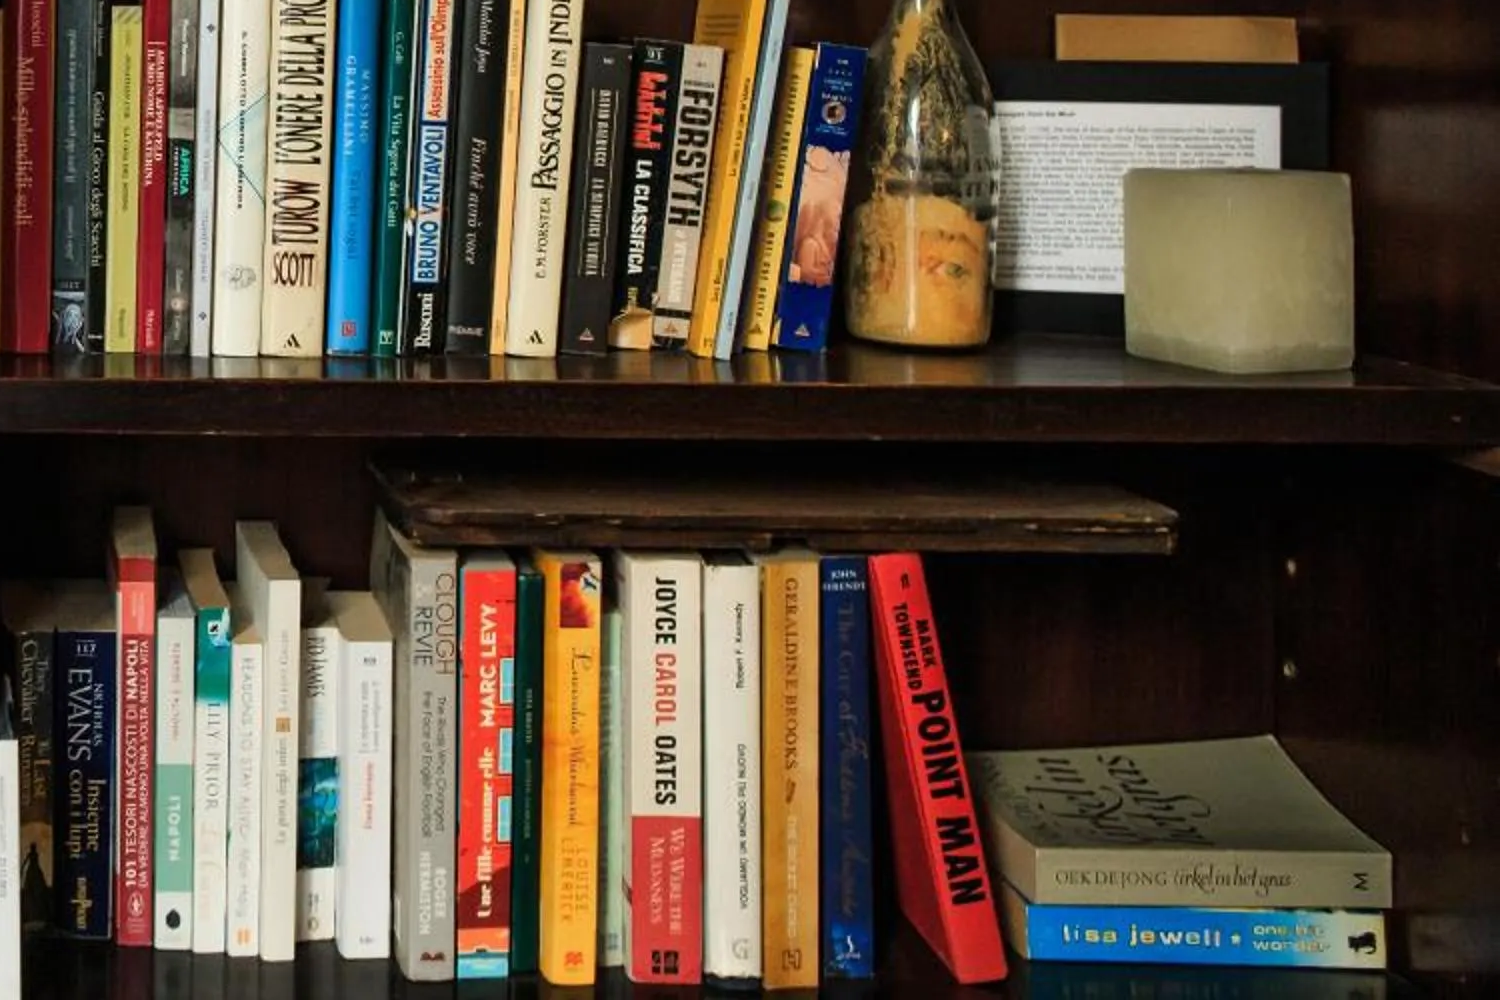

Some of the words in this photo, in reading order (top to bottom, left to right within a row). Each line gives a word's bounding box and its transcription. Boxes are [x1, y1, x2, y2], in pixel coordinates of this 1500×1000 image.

[15, 56, 34, 104] Mille
[277, 35, 325, 87] DELLA
[91, 90, 105, 129] Guida
[342, 55, 356, 156] GRAMELLINI
[359, 69, 371, 144] MASSIMO
[390, 112, 403, 136] Vita
[391, 95, 404, 109] La
[531, 73, 567, 191] PASSAGGIO
[550, 49, 563, 68] IN
[14, 106, 33, 189] splendidi
[92, 132, 105, 143] al
[275, 92, 323, 166] L'ONERE
[90, 146, 104, 184] Gioco
[179, 147, 191, 196] AFRICA
[386, 138, 402, 176] Segreta
[420, 128, 445, 215] VENTAVOLI
[634, 159, 652, 180] LA
[667, 89, 715, 228] FORSYTH
[15, 191, 32, 226] soli
[87, 187, 104, 218] degli
[388, 179, 400, 197] dei
[273, 179, 321, 246] TUROW
[386, 200, 398, 228] Gatti
[626, 184, 651, 275] CLASSIFICA
[89, 222, 103, 267] Scacchi
[416, 220, 438, 279] BRUNO
[464, 233, 479, 265] voce
[274, 252, 317, 287] SCOTT
[435, 572, 455, 675] CLOUGH
[481, 603, 498, 657] LEVY
[655, 576, 677, 645] JOYCE
[783, 577, 800, 691] GERALDINE
[139, 641, 149, 665] VITA
[413, 605, 434, 667] REVIE
[892, 602, 924, 691] TOWNSEND
[915, 618, 937, 669] MARK
[19, 638, 39, 725] Chevalier
[125, 639, 138, 700] NAPOLI
[139, 668, 149, 703] NELLA
[241, 657, 255, 726] REASONS
[655, 653, 677, 726] CAROL
[67, 668, 92, 761] EVANS
[93, 683, 104, 746] NICHOLAS
[126, 704, 138, 720] DI
[422, 691, 432, 707] the
[437, 696, 447, 715] The
[480, 664, 497, 728] MARC
[139, 707, 149, 742] VOLTA
[206, 701, 222, 741] LILY
[240, 731, 253, 752] TO
[422, 711, 432, 738] Face
[784, 695, 800, 771] BROOKS
[911, 689, 965, 800] POINT
[126, 724, 138, 799] NASCOSTI
[139, 745, 149, 770] UNA
[422, 741, 432, 754] of
[437, 749, 447, 774] Who
[655, 735, 677, 806] OATES
[68, 768, 85, 804] con
[205, 751, 221, 811] PRIOR
[240, 757, 253, 791] STAY
[86, 778, 107, 852] Insieme
[139, 773, 149, 823] ALMENO
[66, 824, 88, 860] lupi
[126, 802, 138, 854] TESORI
[139, 826, 149, 869] VEDERE
[167, 795, 180, 862] NAPOLI
[669, 827, 685, 852] WE
[126, 860, 137, 887] 101
[139, 870, 149, 888] DA
[670, 856, 685, 903] WERE
[935, 816, 986, 906] MAN
[1055, 870, 1092, 886] OEK
[670, 906, 682, 936] THE
[1063, 924, 1117, 944] lisa
[1129, 924, 1222, 947] jewell
